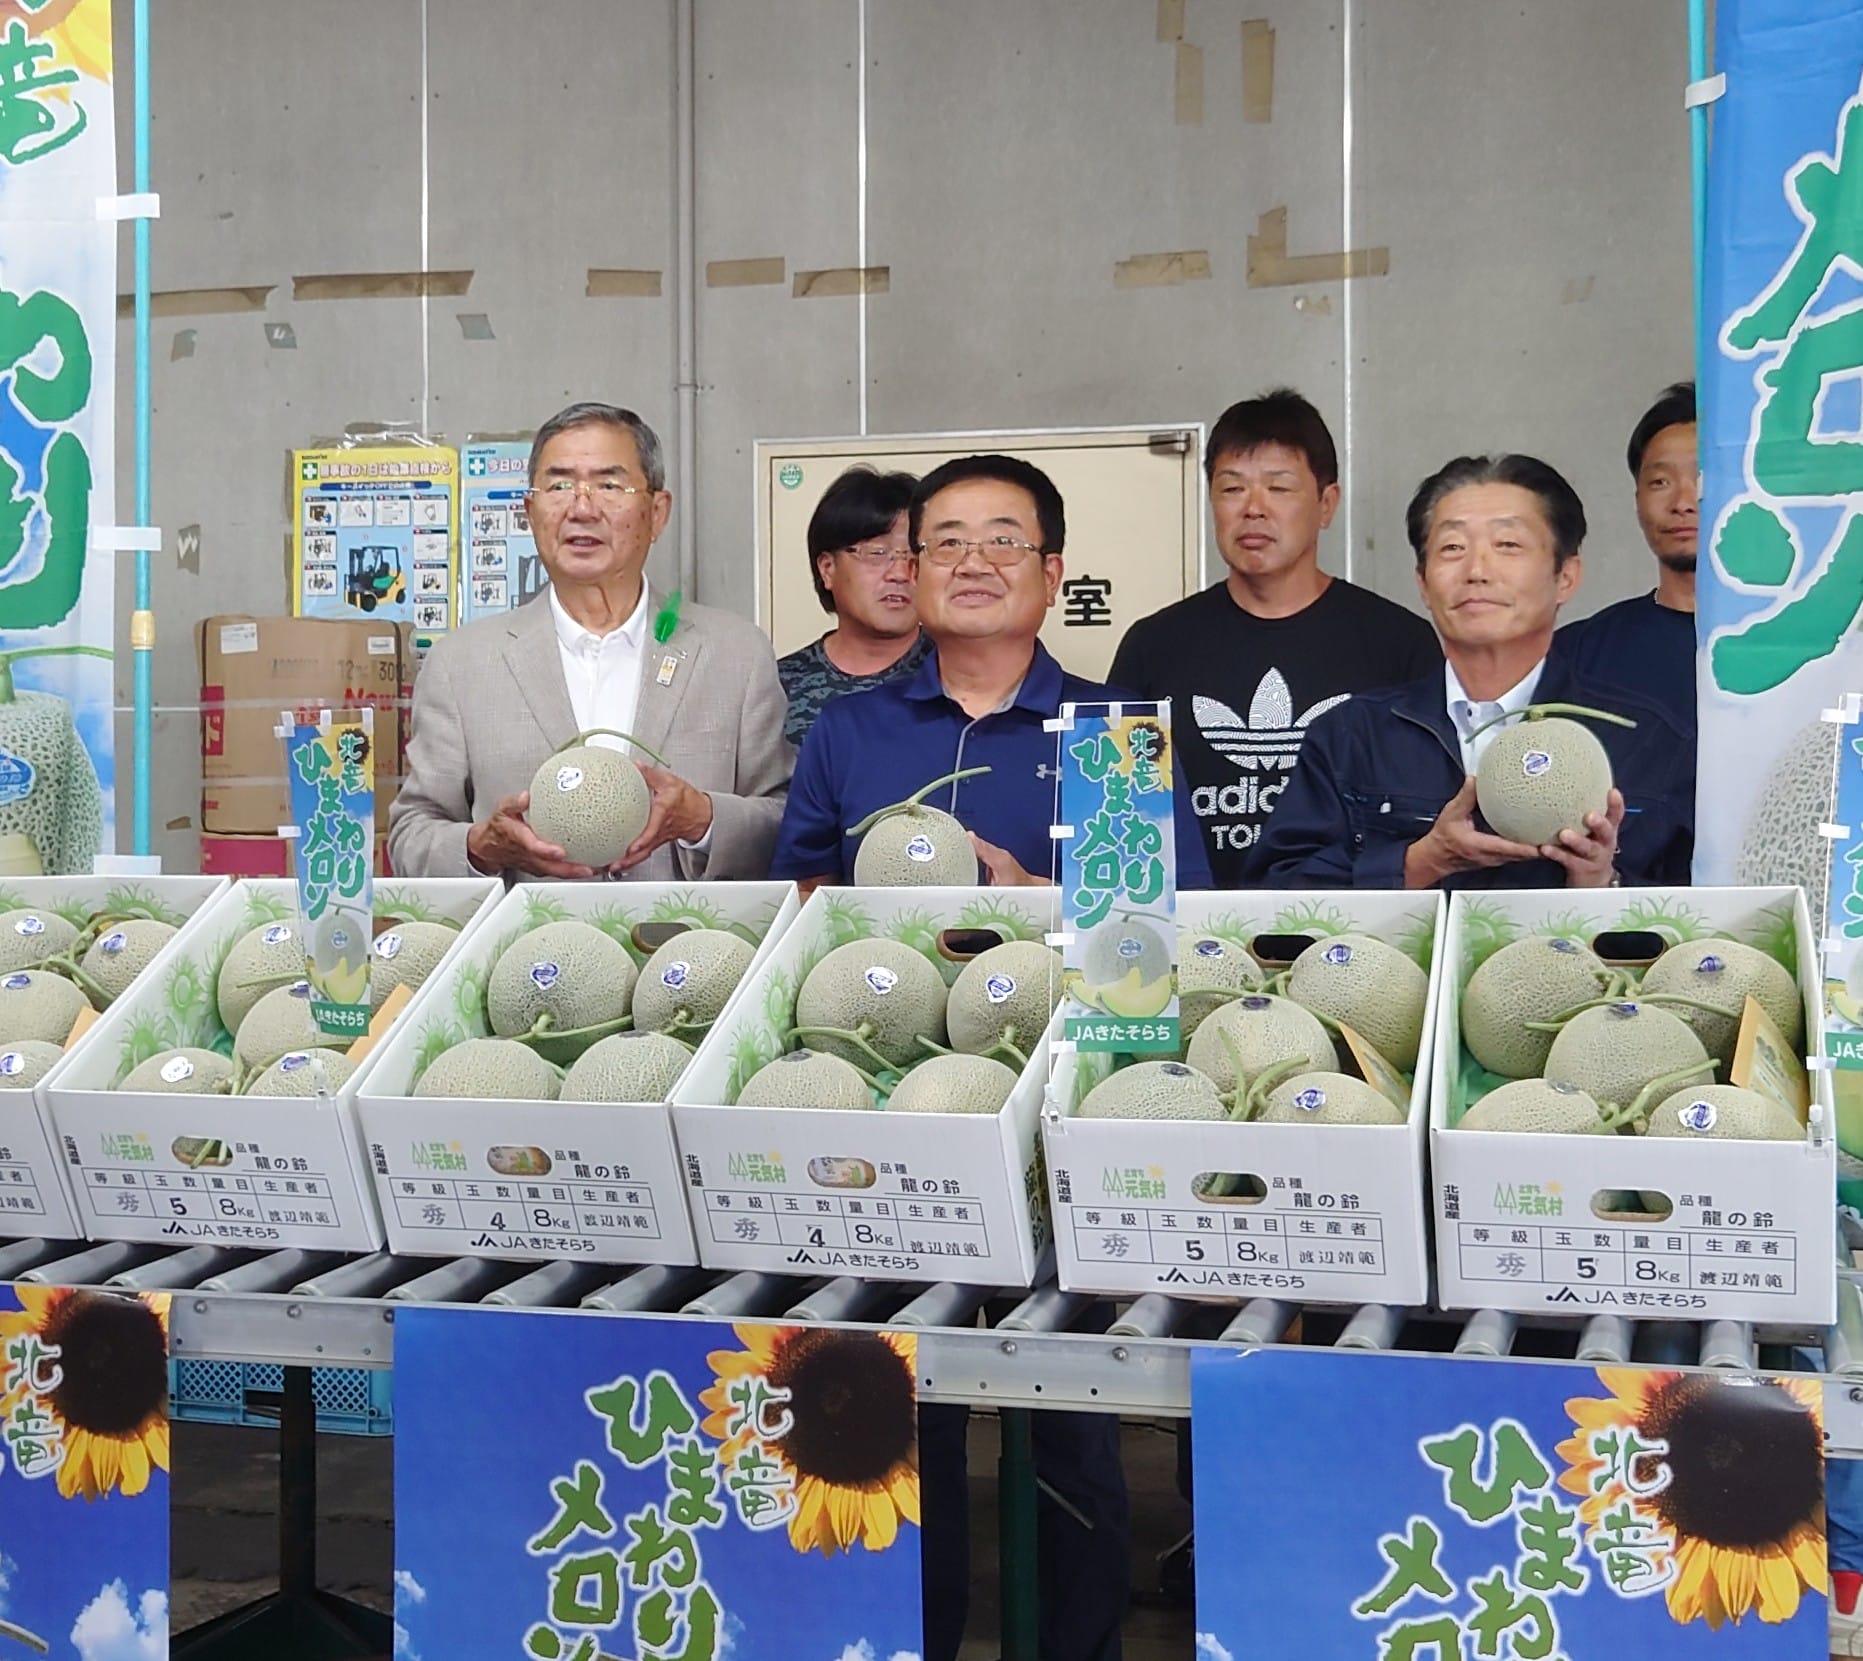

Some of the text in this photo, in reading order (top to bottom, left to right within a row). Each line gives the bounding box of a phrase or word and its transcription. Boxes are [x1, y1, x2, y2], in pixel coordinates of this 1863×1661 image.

[1063, 574, 1113, 627] 室
[1211, 824, 1261, 850] TO
[1072, 811, 1121, 930] メロン
[1072, 1023, 1171, 1042] JAきたそらち
[254, 1156, 309, 1172] 龍の鈴
[575, 1165, 631, 1180] 龍の鈴
[685, 1153, 704, 1187] 北海道産
[748, 1164, 787, 1183] 元気村
[880, 1163, 908, 1175] 品種
[155, 1175, 198, 1190] 玉数
[211, 1177, 249, 1191] 量目
[264, 1180, 319, 1195] 生産者
[402, 1182, 640, 1204] 等級 玉数 量目 生産者
[900, 1177, 961, 1195] 龍の鈴
[1054, 1169, 1072, 1204] 北海道産
[1125, 1179, 1166, 1199] 元気村
[1272, 1177, 1303, 1189] 品種
[117, 1191, 139, 1212] 秀
[170, 1198, 187, 1216] 5
[716, 1194, 969, 1220] 等級 玉数 量目 生産者
[1294, 1192, 1360, 1210] 龍の鈴
[1443, 1184, 1460, 1220] 北海道産
[1518, 1195, 1563, 1216] 元気村
[1680, 1194, 1713, 1207] 品種
[421, 1203, 446, 1225] 秀
[490, 1212, 506, 1231] 4
[1085, 1211, 1367, 1236] 等級 玉数 量目 生産者
[1702, 1211, 1774, 1228] 龍の鈴
[734, 1217, 760, 1241] 秀
[807, 1226, 826, 1248] 4
[1473, 1228, 1779, 1255] 等級 玉数 量目 生産者
[1102, 1233, 1130, 1257] 秀
[1185, 1240, 1205, 1261] 5
[1495, 1252, 1526, 1277] 秀
[1577, 1257, 1597, 1279] 5
